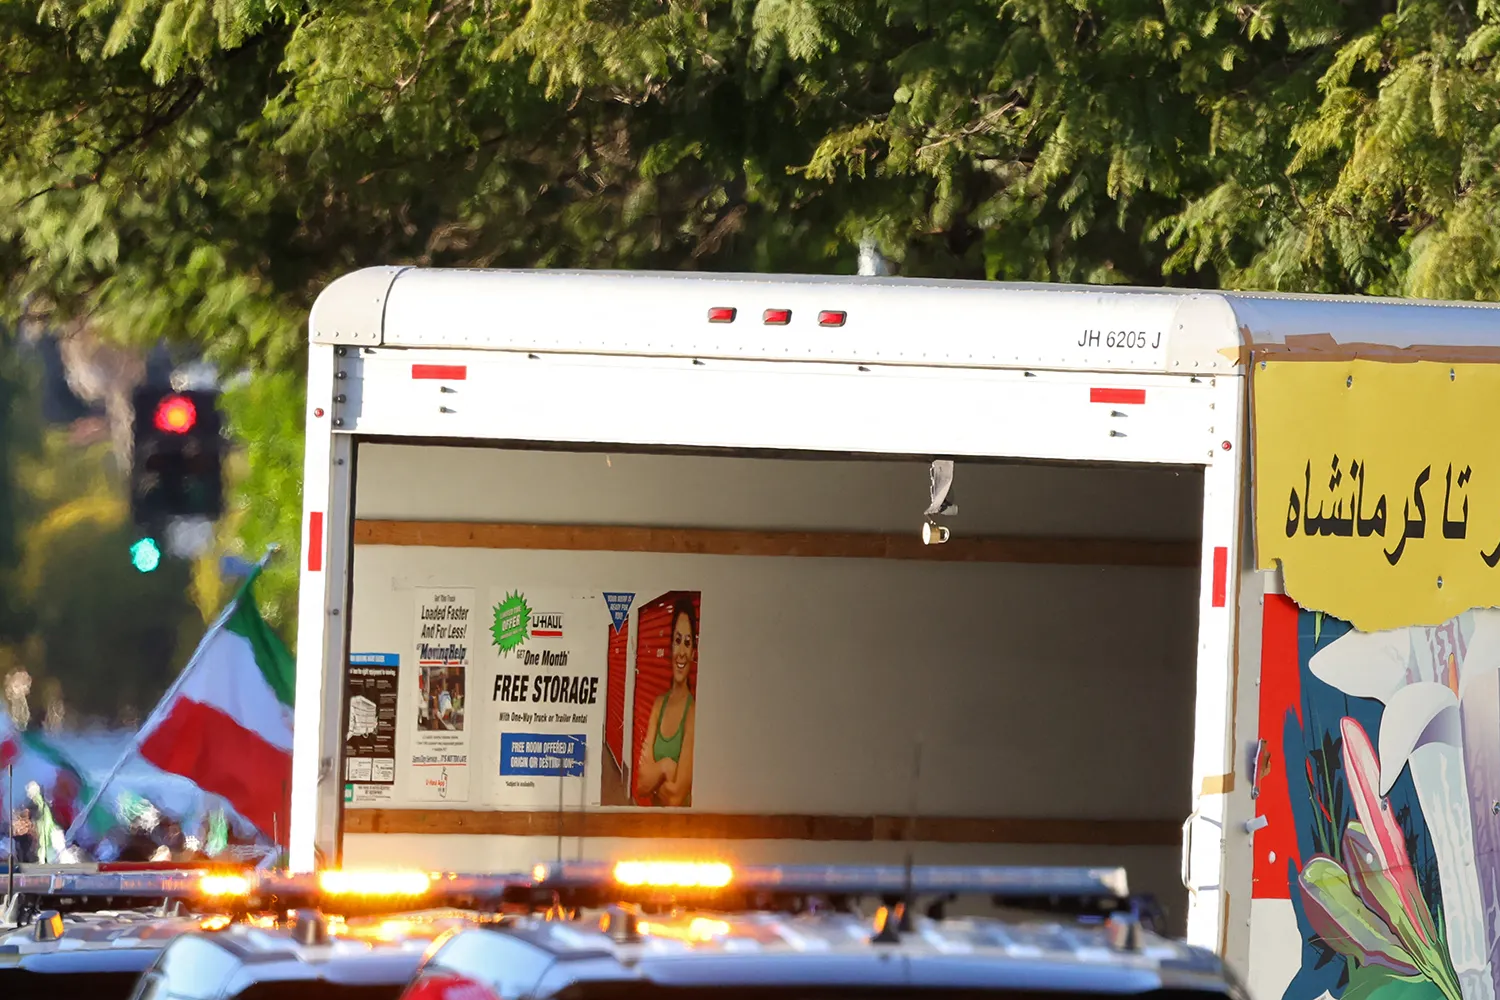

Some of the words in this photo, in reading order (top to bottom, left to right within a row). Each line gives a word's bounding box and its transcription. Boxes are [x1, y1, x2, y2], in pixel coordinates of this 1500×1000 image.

[1078, 329, 1101, 347] JH
[1106, 331, 1146, 348] 6205
[1151, 332, 1161, 349] J
[1442, 462, 1472, 540] تا
[1285, 453, 1432, 567] کرمانشاه
[421, 605, 446, 620] Loaded
[447, 605, 469, 620] Faster
[532, 615, 562, 629] U-HAUL
[421, 624, 435, 639] And
[435, 624, 447, 639] For
[448, 624, 467, 639] Less!
[524, 650, 540, 666] One
[493, 674, 529, 702] FREE
[532, 675, 599, 704] STORAGE
[500, 712, 510, 721] With
[511, 712, 533, 724] One-Way
[534, 713, 547, 722] Truck
[556, 714, 571, 723] Trailer
[572, 714, 588, 723] Rental
[512, 742, 525, 753] FREE
[526, 742, 542, 753] ROOM
[544, 742, 567, 754] OFFERED
[567, 743, 575, 754] AT
[529, 757, 538, 768] OR
